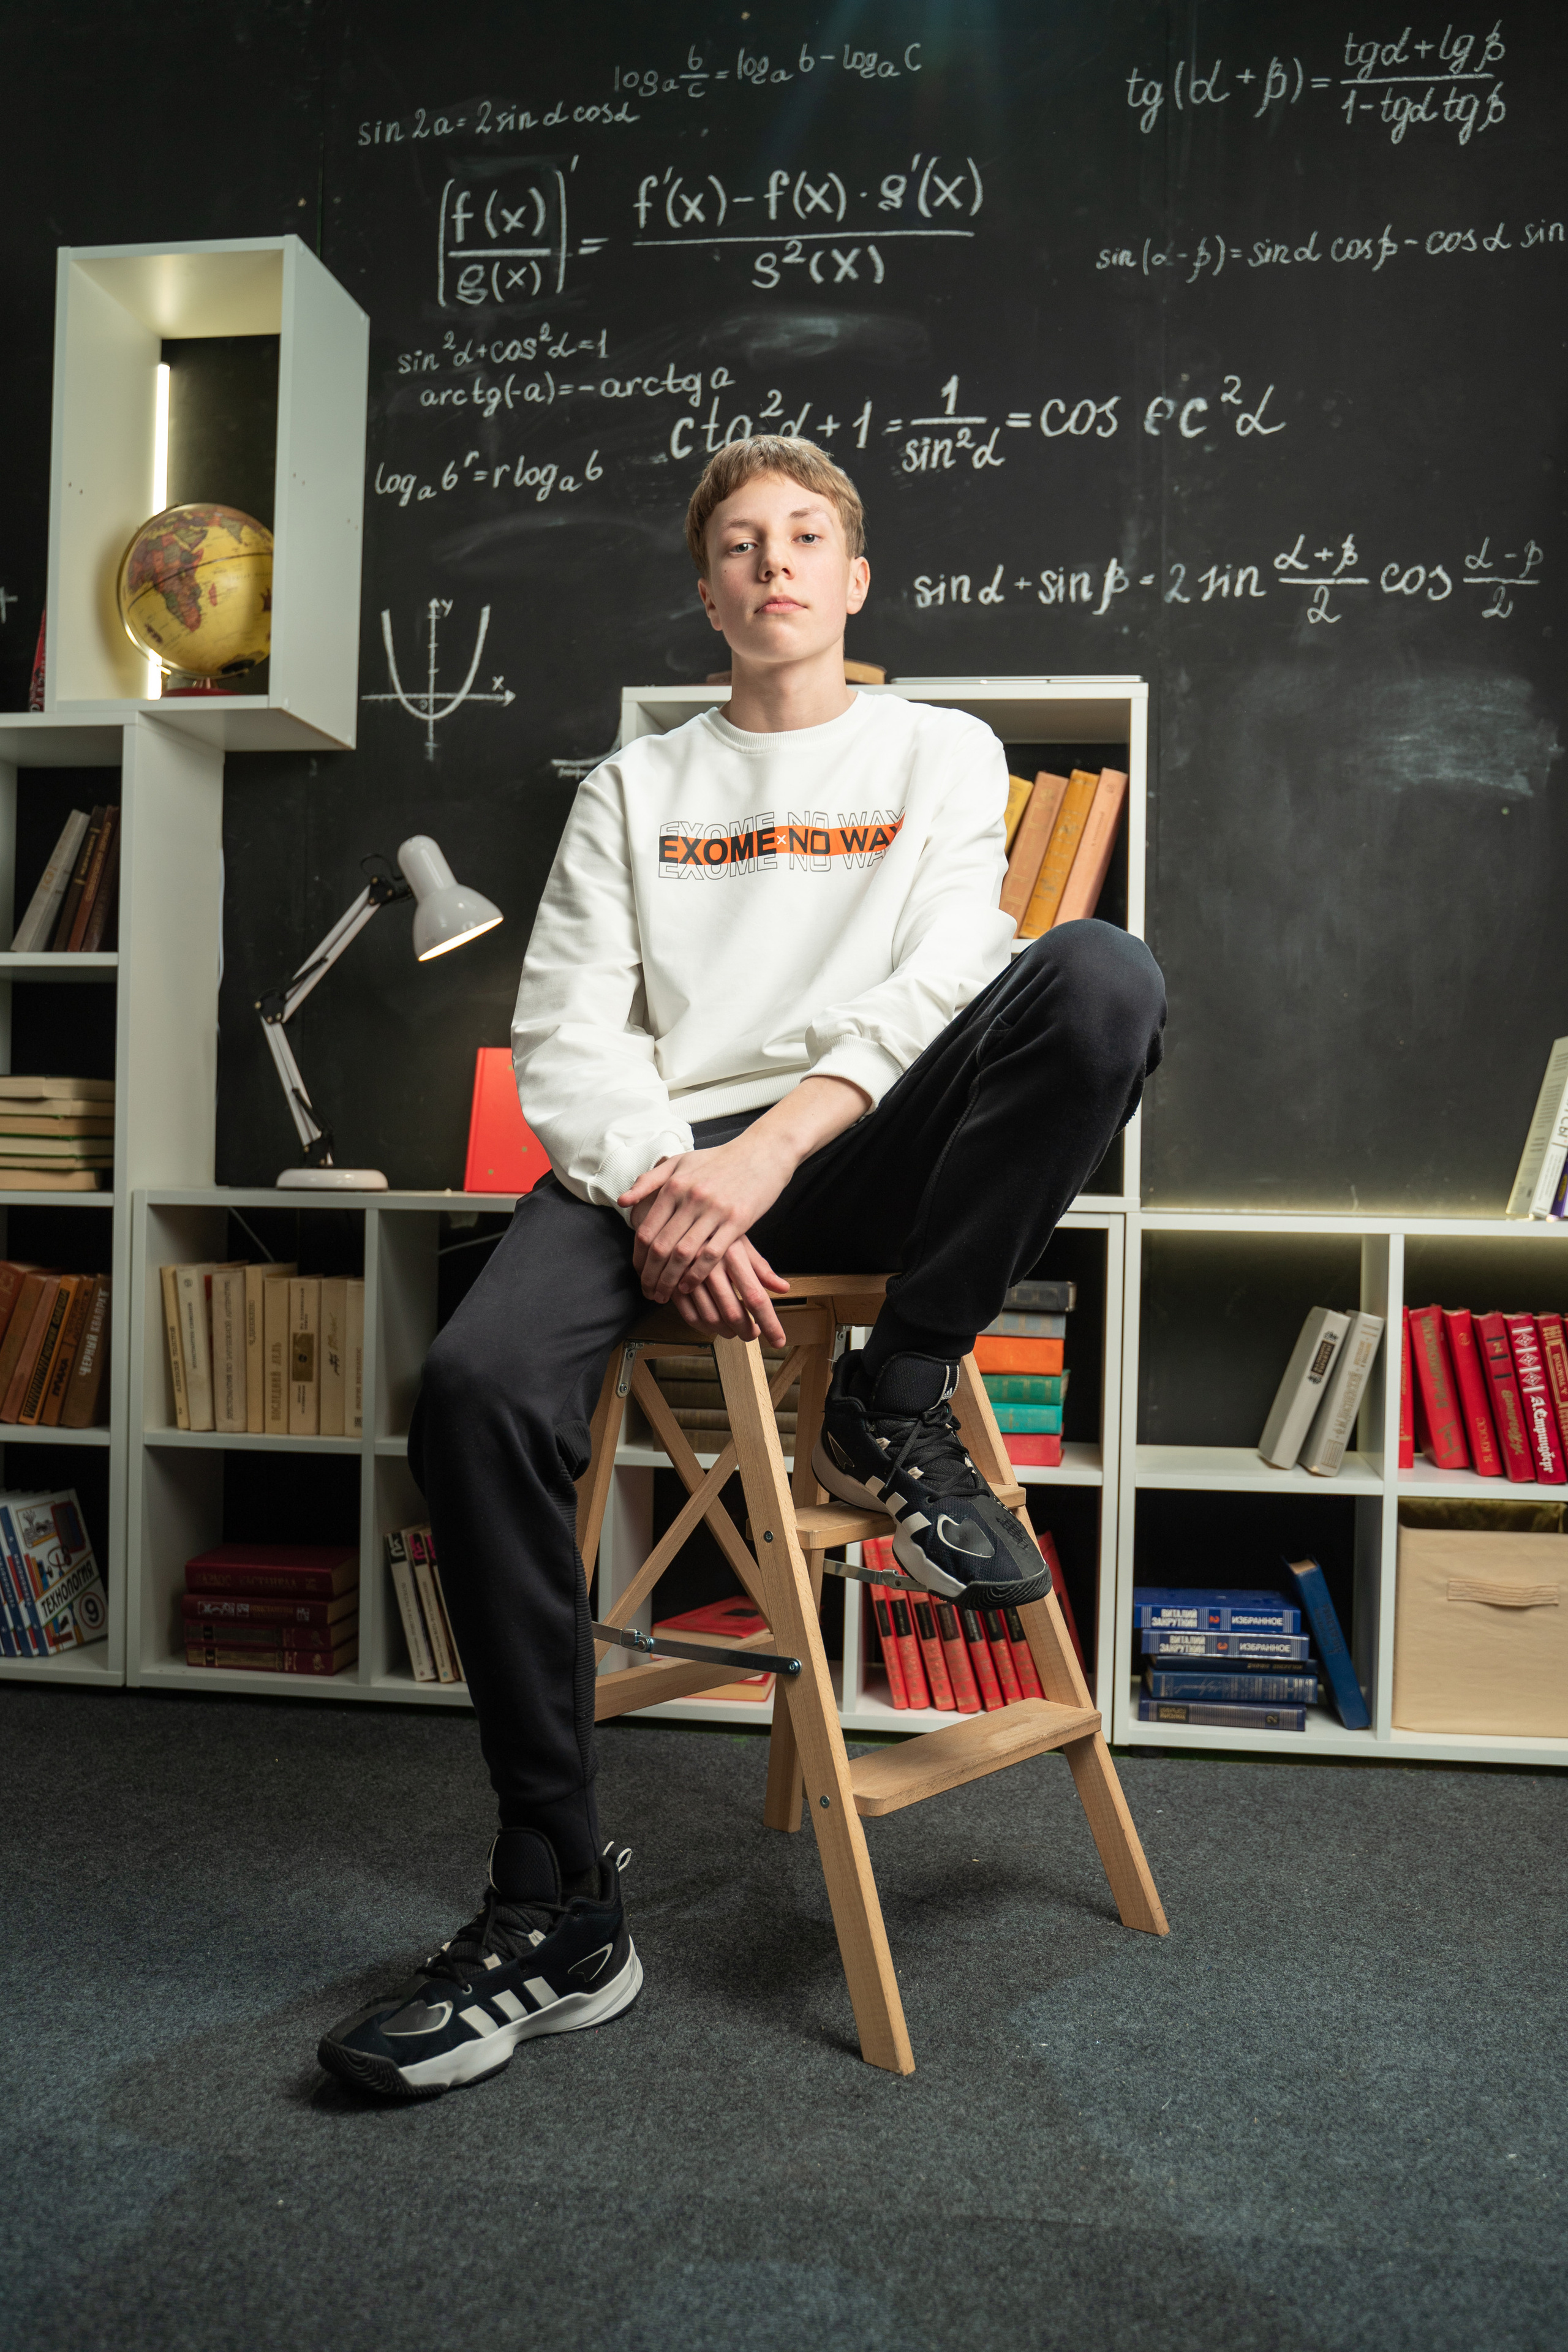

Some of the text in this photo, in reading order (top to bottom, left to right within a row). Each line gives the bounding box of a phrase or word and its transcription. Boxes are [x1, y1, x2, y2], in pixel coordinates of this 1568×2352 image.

[659, 827, 777, 865] EXOME
[788, 828, 830, 854] NO
[78, 1287, 110, 1374] ЧЕРНЫЙ КВАДРАТ
[40, 1563, 94, 1619] ТЕХНОЛОГИЯ
[85, 1599, 100, 1624] 9
[1231, 1616, 1283, 1627] ИЗБРАННОЕ
[1239, 1642, 1291, 1653] ИЗБРАННОЕ
